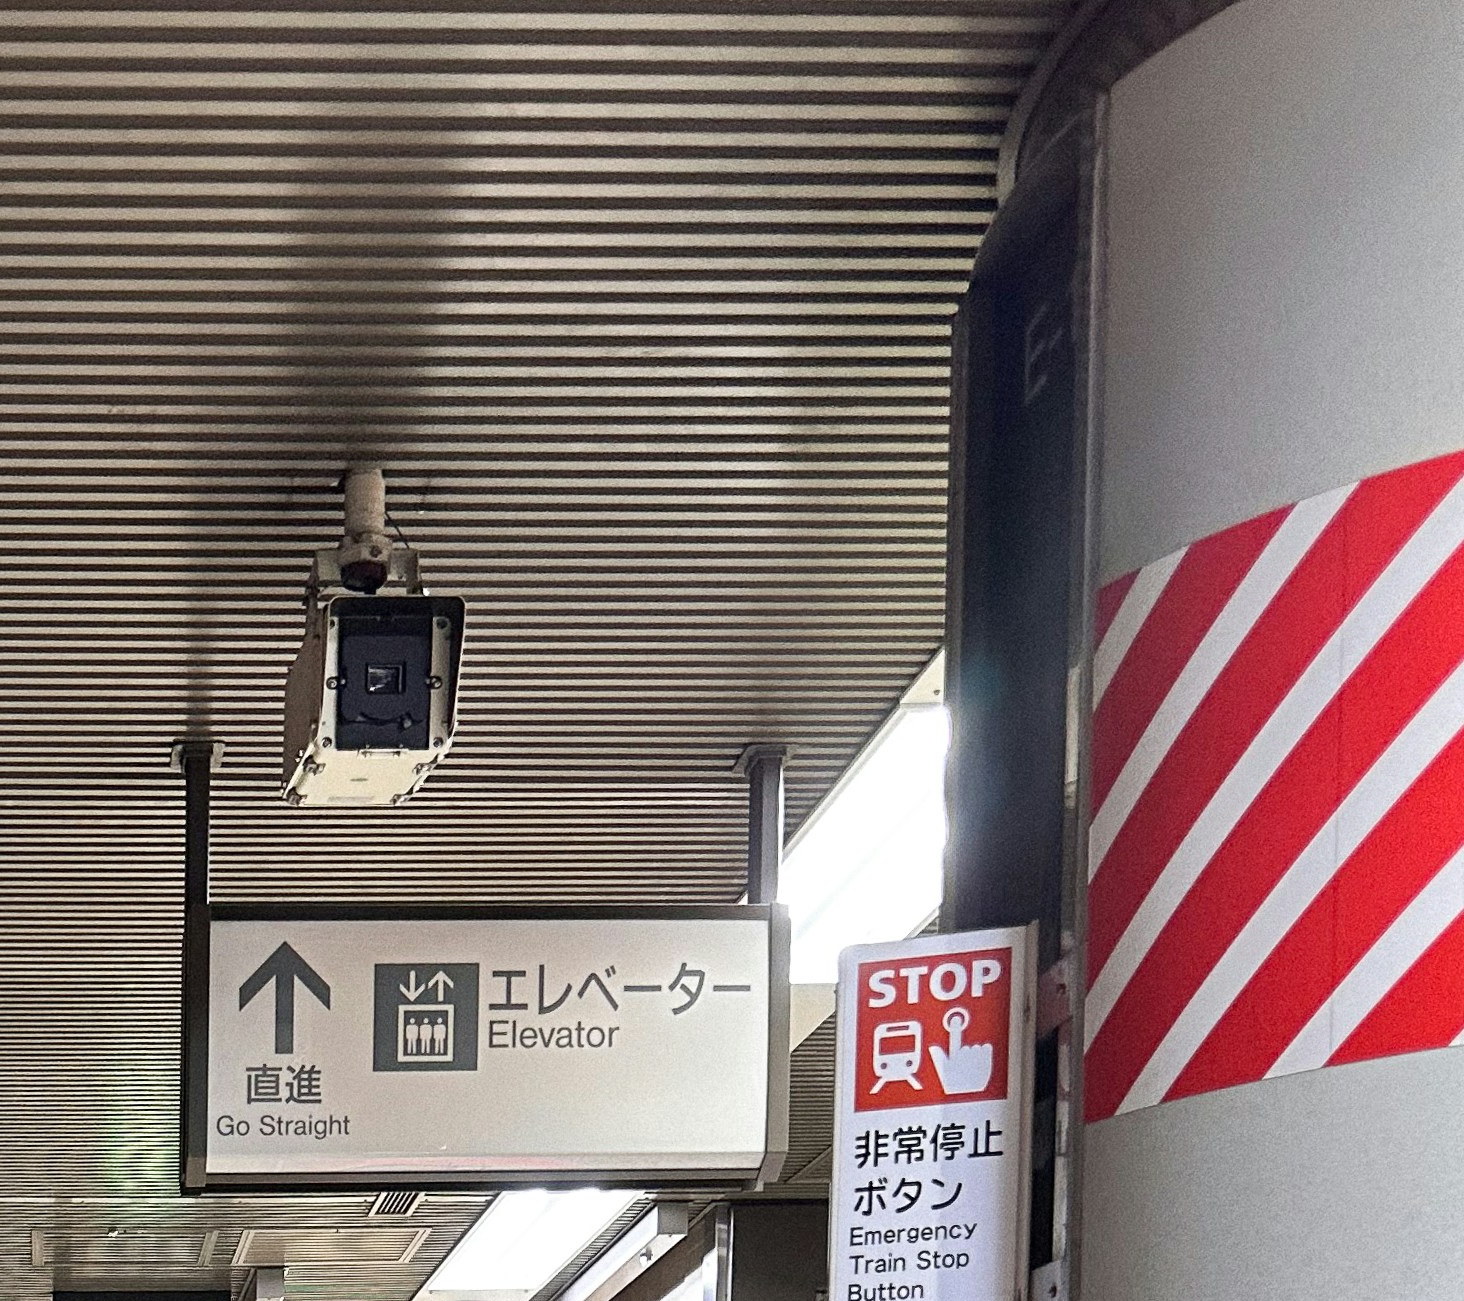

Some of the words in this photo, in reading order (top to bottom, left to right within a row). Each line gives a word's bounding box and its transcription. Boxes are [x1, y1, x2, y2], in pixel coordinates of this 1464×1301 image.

[488, 963, 751, 1016] エレベーター
[868, 959, 1002, 1008] STOP
[489, 1019, 620, 1048] Elevator
[245, 1063, 322, 1105] 直進
[216, 1115, 250, 1137] Go
[258, 1114, 351, 1140] Straight
[855, 1119, 1004, 1168] 非常停止
[854, 1178, 963, 1216] ボタン
[850, 1222, 977, 1248] Emergency
[850, 1254, 906, 1275] Train
[916, 1250, 970, 1271] Stop
